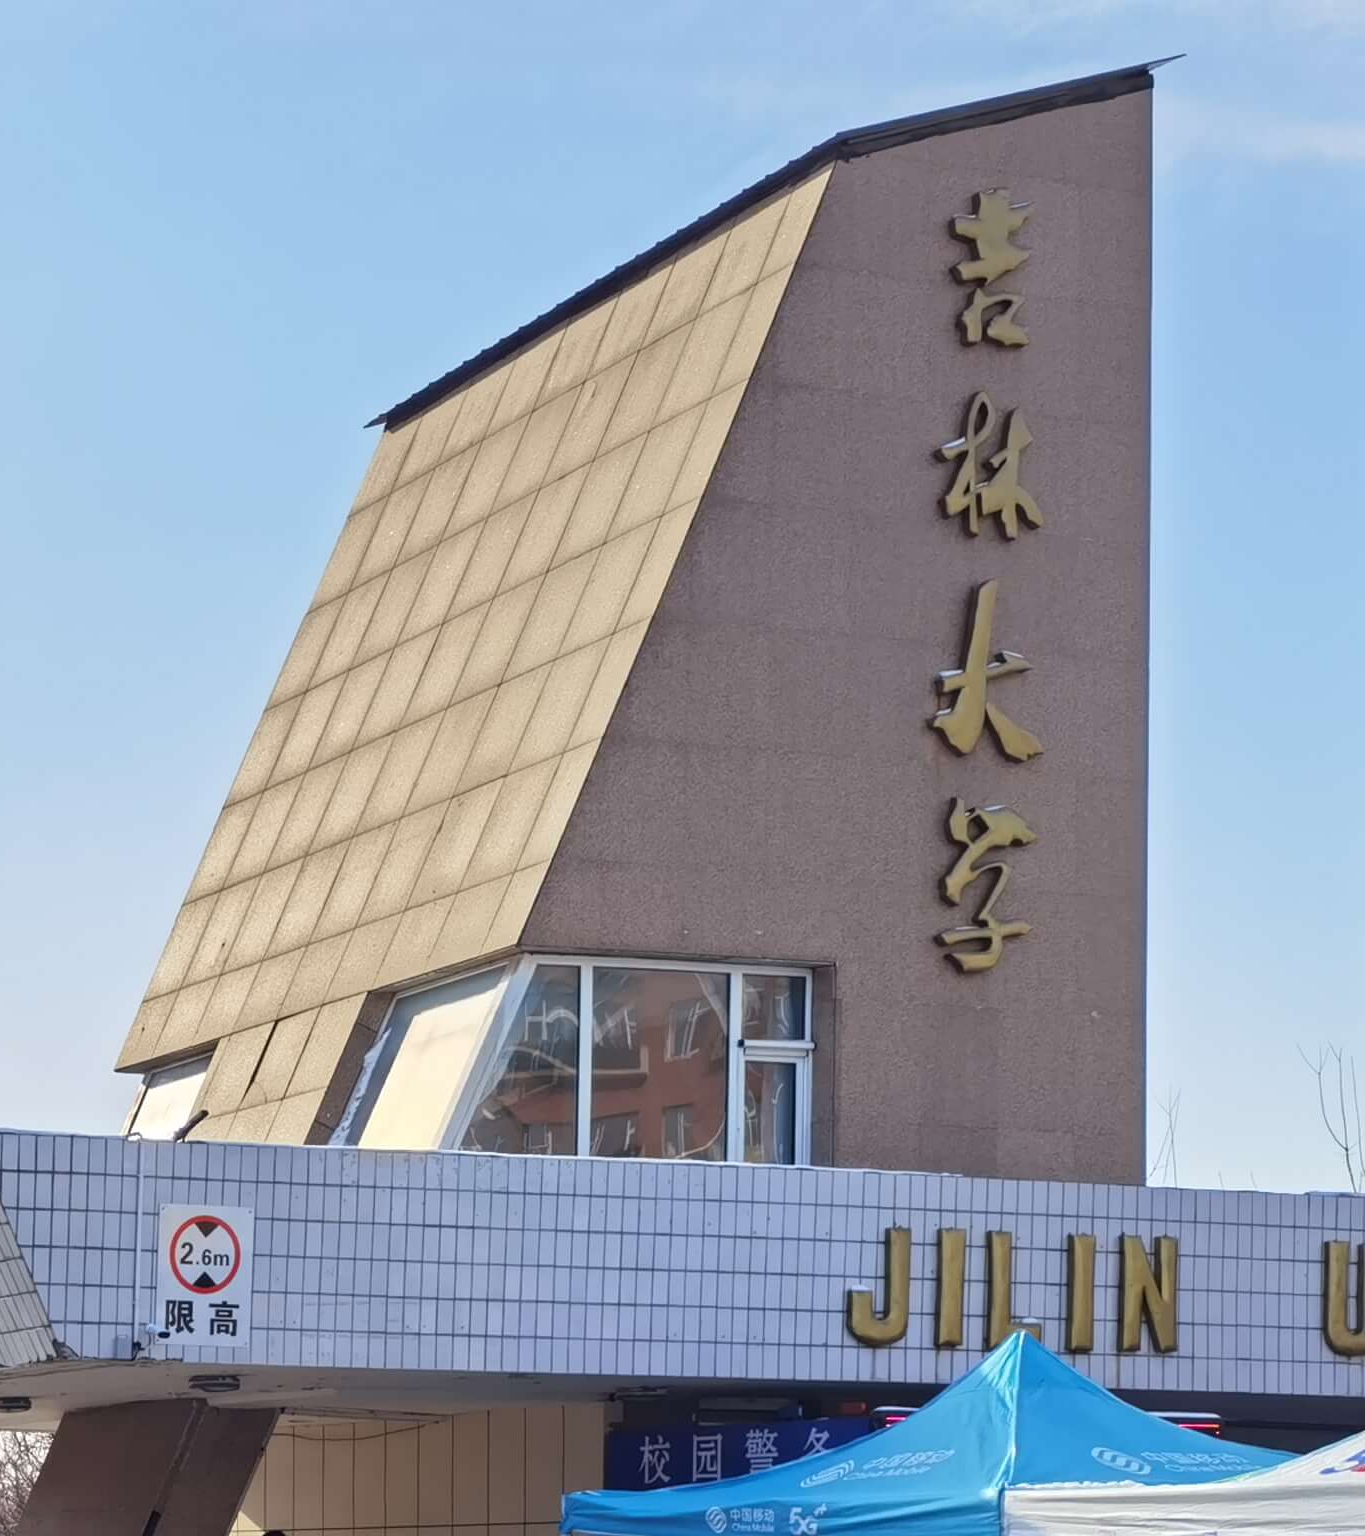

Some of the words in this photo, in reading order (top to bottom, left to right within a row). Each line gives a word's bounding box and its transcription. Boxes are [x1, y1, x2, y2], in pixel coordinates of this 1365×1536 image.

[928, 187, 1045, 975] 吉林大学
[180, 1242, 229, 1266] 2.6m
[846, 1226, 1178, 1353] JILIN
[164, 1300, 240, 1336] 限高
[730, 1508, 774, 1522] 中国移动
